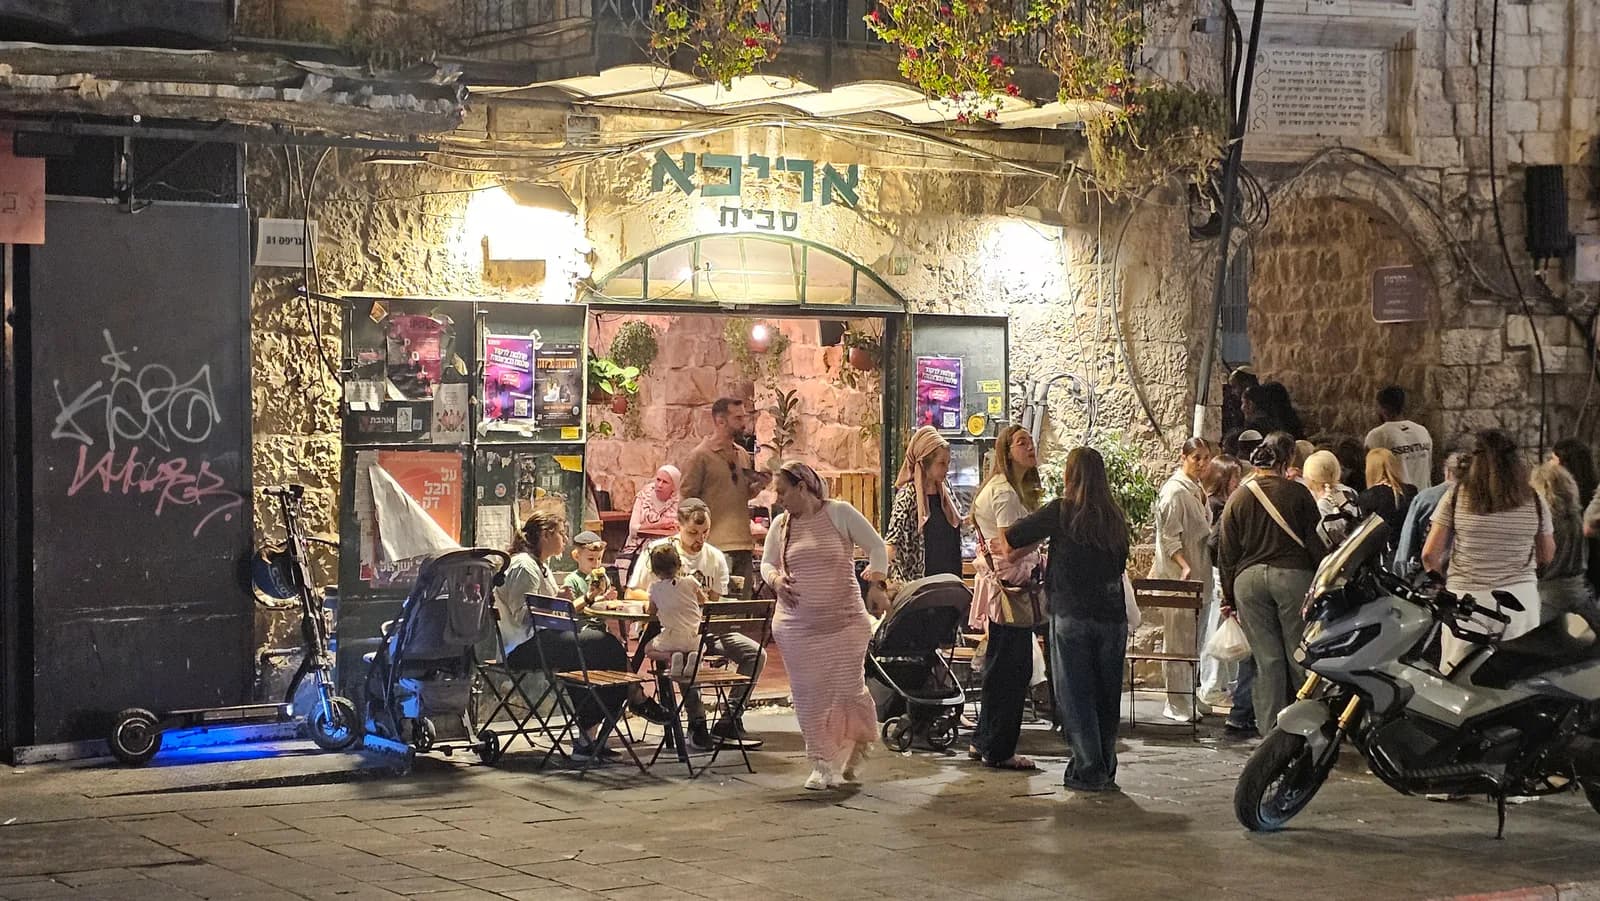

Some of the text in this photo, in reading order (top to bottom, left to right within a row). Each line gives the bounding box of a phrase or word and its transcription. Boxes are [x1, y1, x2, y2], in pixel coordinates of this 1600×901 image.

[651, 148, 860, 207] אריכא
[719, 206, 798, 232] סביח
[279, 236, 306, 246] גריפס
[441, 467, 457, 482] על
[424, 480, 451, 496] חבל
